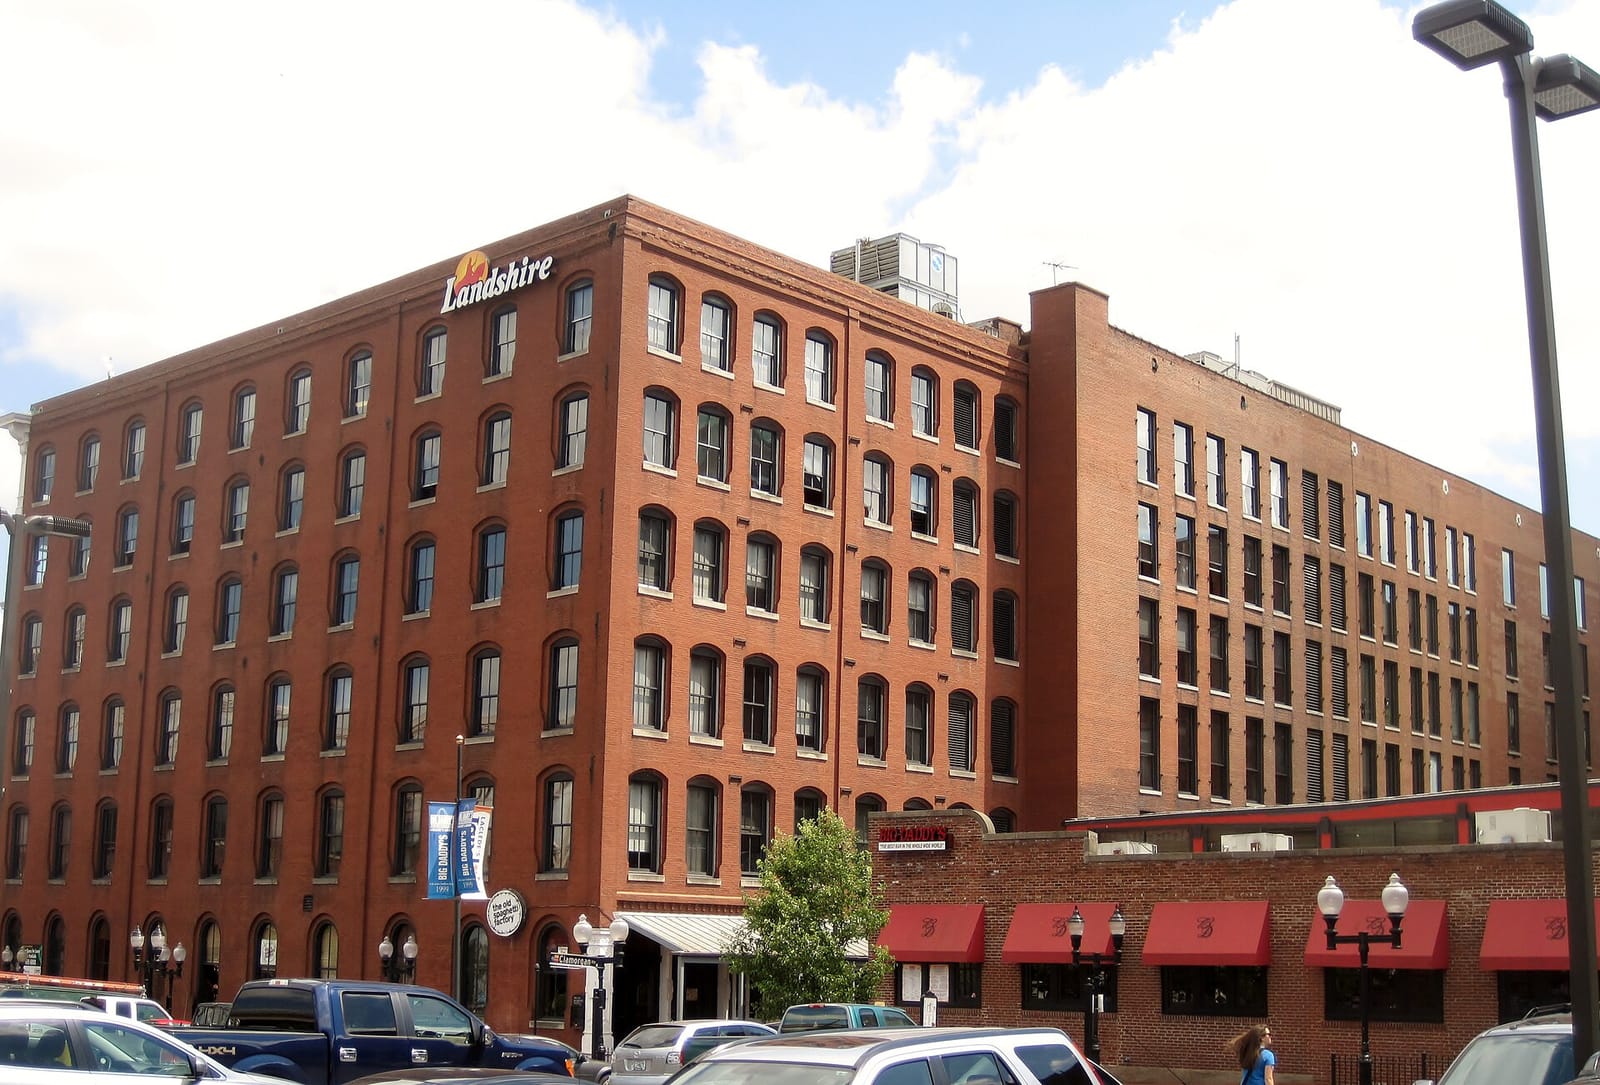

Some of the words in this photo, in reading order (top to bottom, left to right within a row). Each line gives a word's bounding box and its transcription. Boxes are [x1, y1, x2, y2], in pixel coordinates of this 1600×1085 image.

[440, 256, 553, 314] Landshire
[438, 834, 449, 866] DADDY'S
[460, 830, 468, 862] DADDY'S
[438, 867, 448, 880] BIG
[461, 863, 470, 876] BIG
[492, 903, 502, 911] the
[502, 899, 512, 908] old
[493, 905, 519, 918] spaghetti
[493, 914, 514, 928] factory
